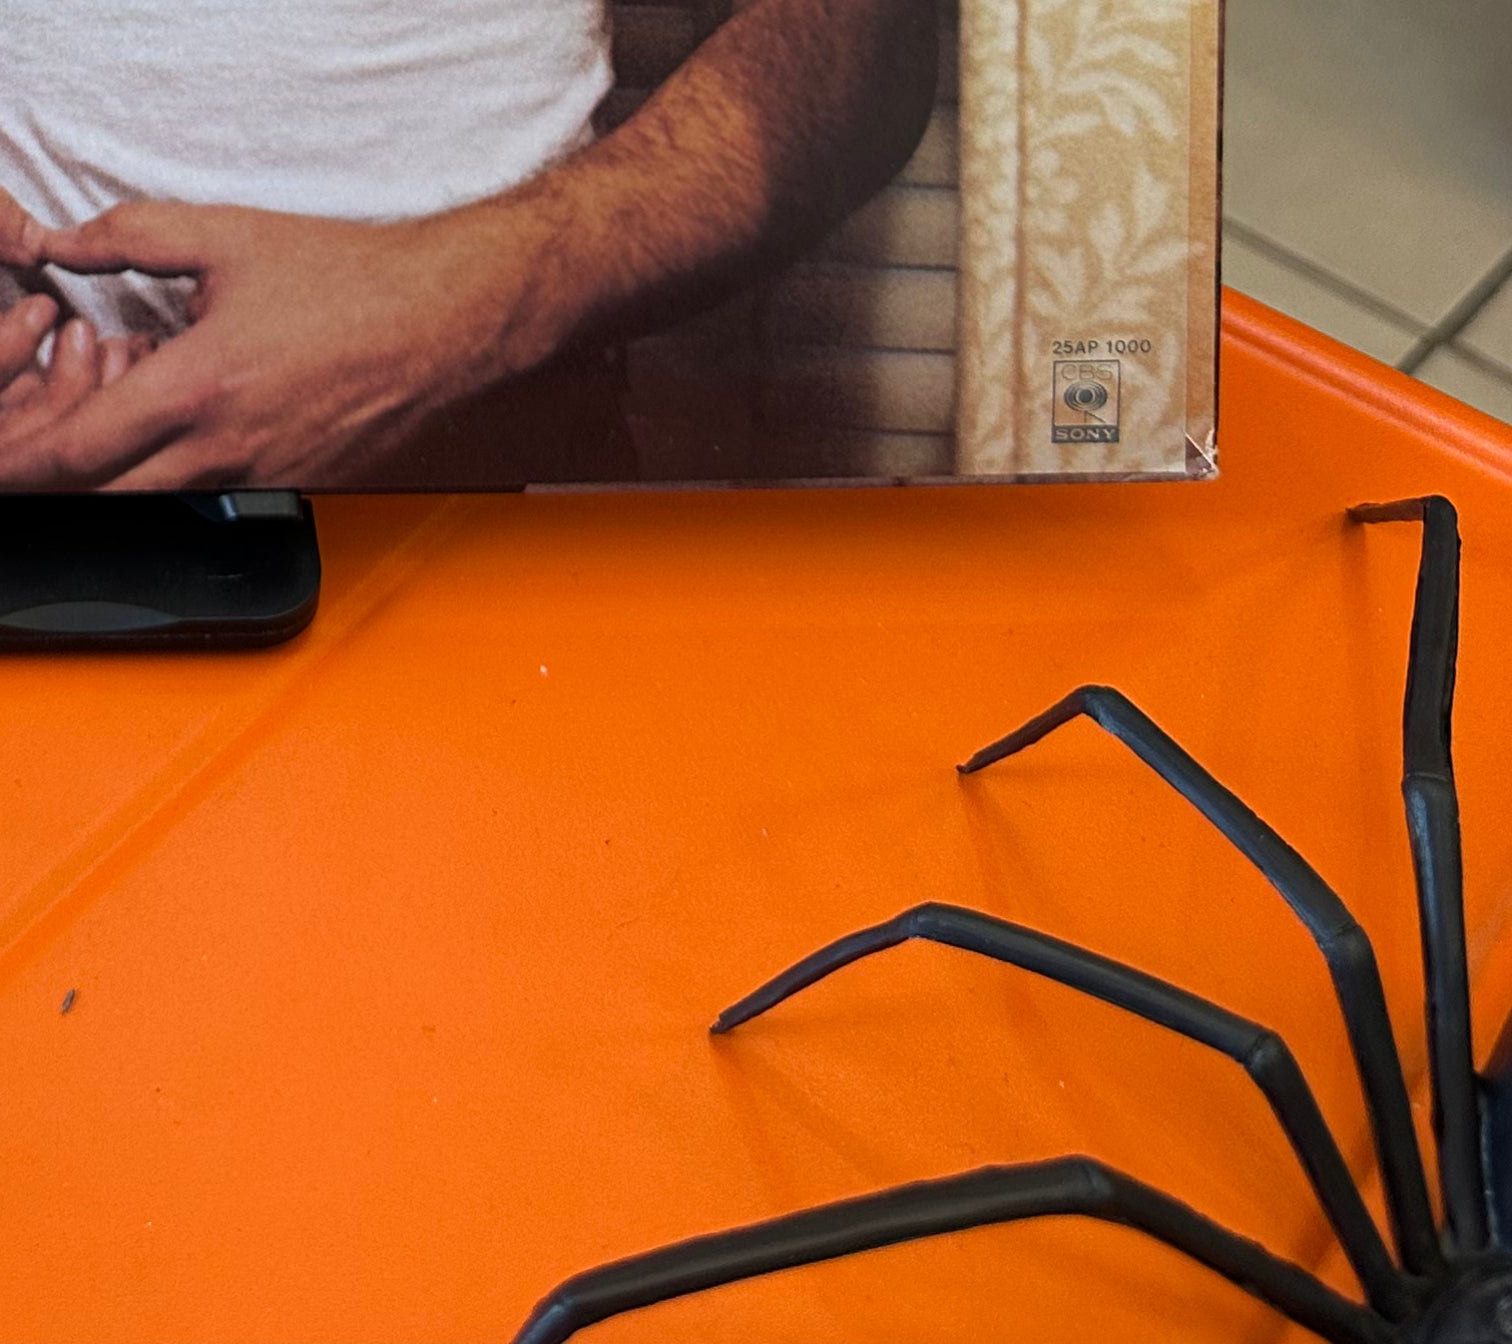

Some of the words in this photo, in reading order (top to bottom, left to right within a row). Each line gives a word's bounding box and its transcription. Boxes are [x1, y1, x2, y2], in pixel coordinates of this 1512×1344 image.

[1053, 340, 1098, 354] 25AP
[1107, 339, 1151, 353] 1000
[1061, 364, 1113, 380] CBS
[1055, 428, 1116, 440] SONY
